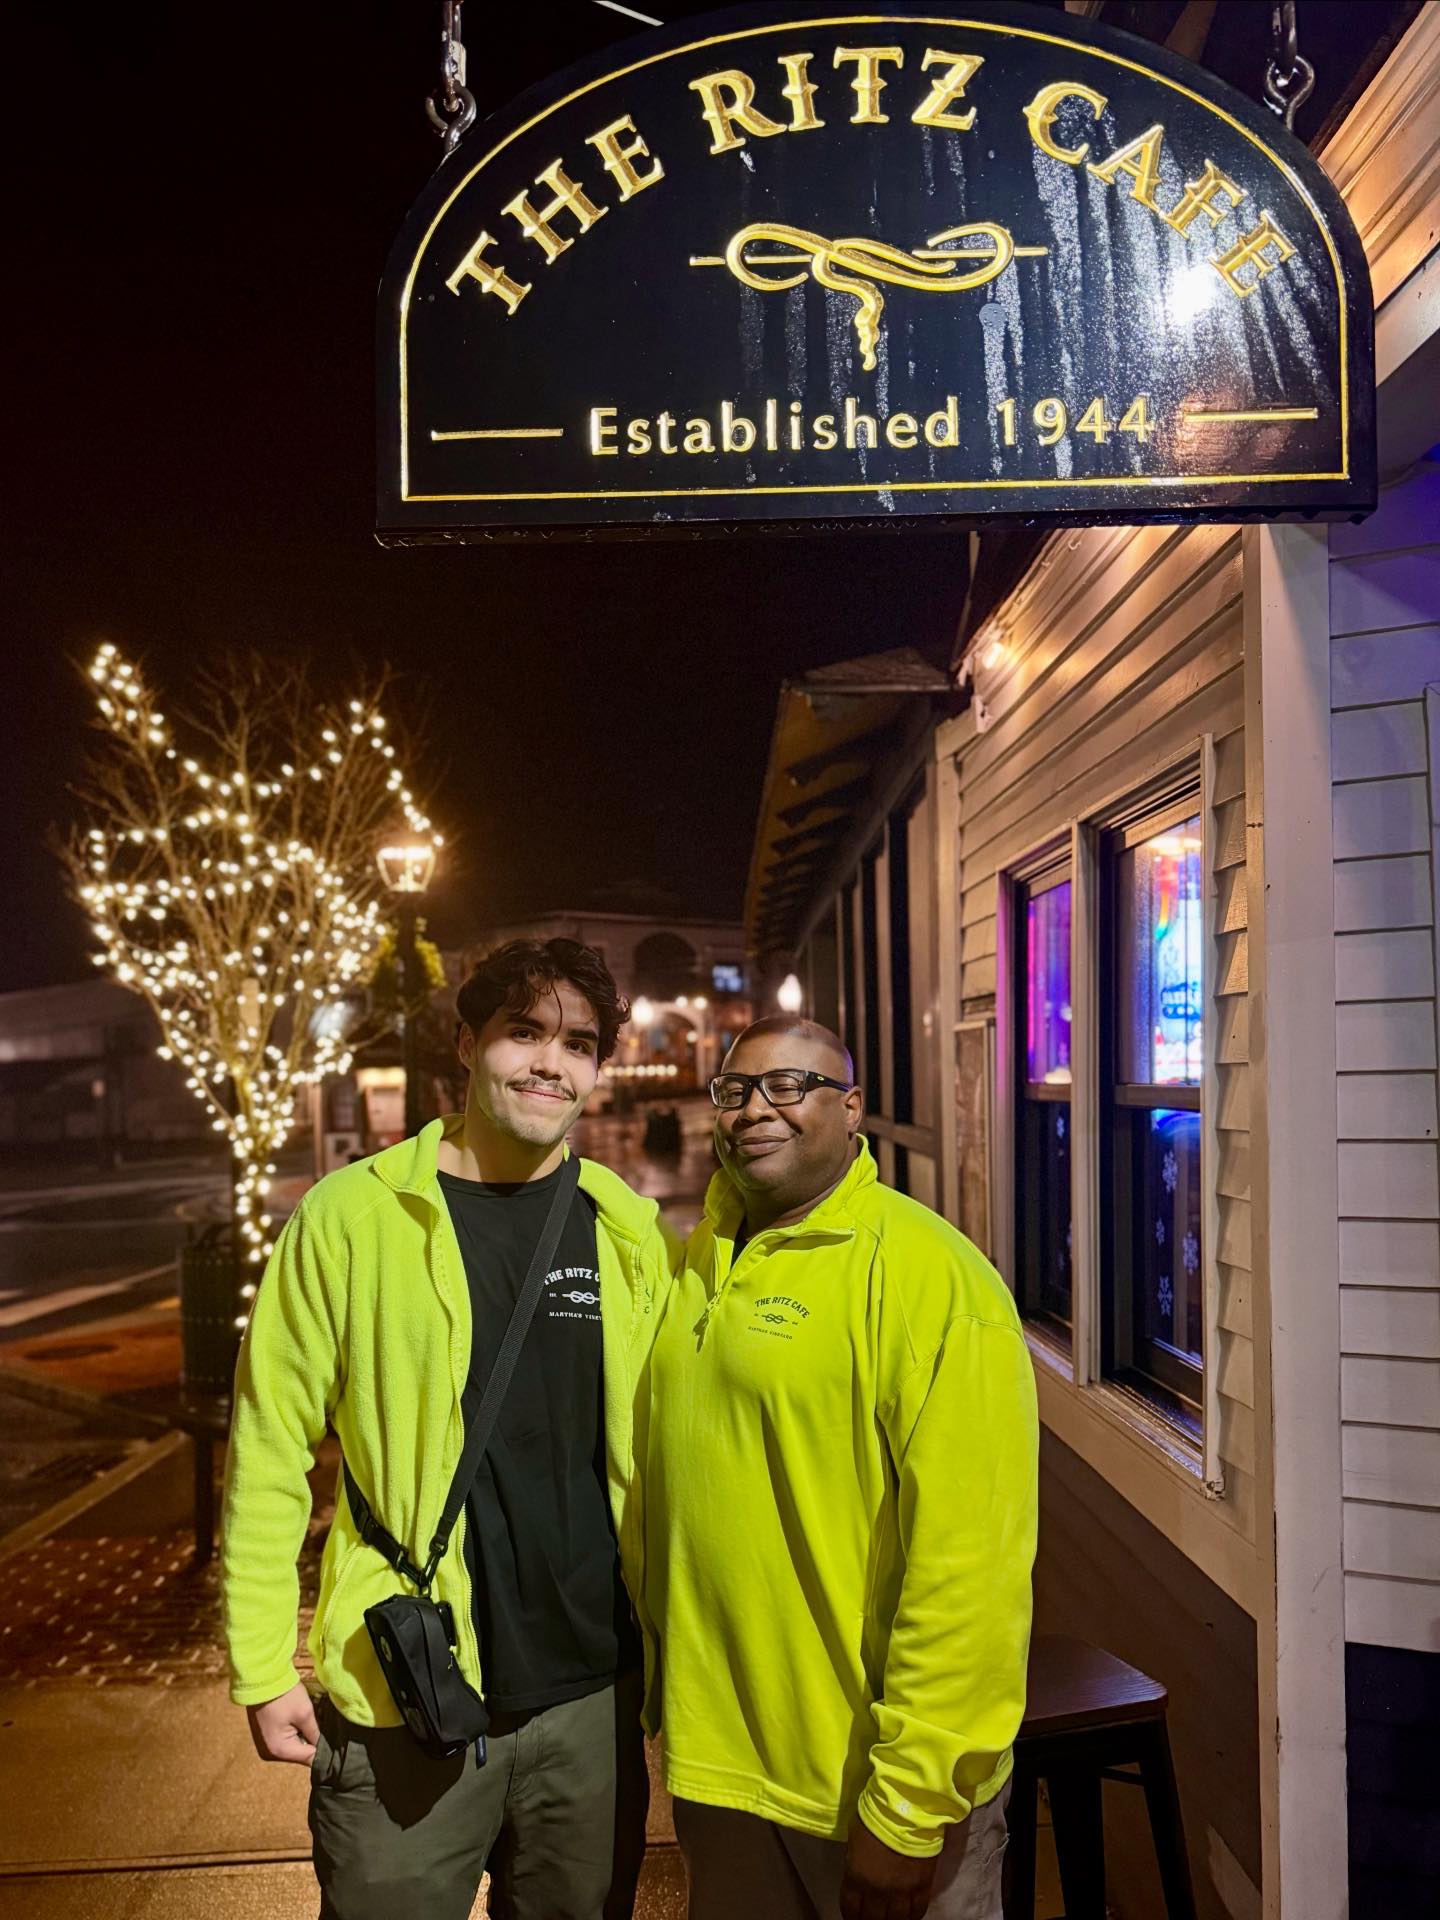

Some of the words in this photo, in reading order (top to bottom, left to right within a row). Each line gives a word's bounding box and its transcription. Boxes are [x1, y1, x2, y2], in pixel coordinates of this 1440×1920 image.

[445, 113, 666, 316] THE
[688, 46, 985, 155] RITZ
[1022, 81, 1298, 298] CAFE
[589, 394, 960, 456] Established
[996, 395, 1154, 446] 1944
[544, 1270, 564, 1286] THE
[565, 1267, 593, 1280] RITZ
[754, 1297, 771, 1308] THE
[772, 1296, 792, 1306] RITZ
[791, 1300, 810, 1319] CAFE
